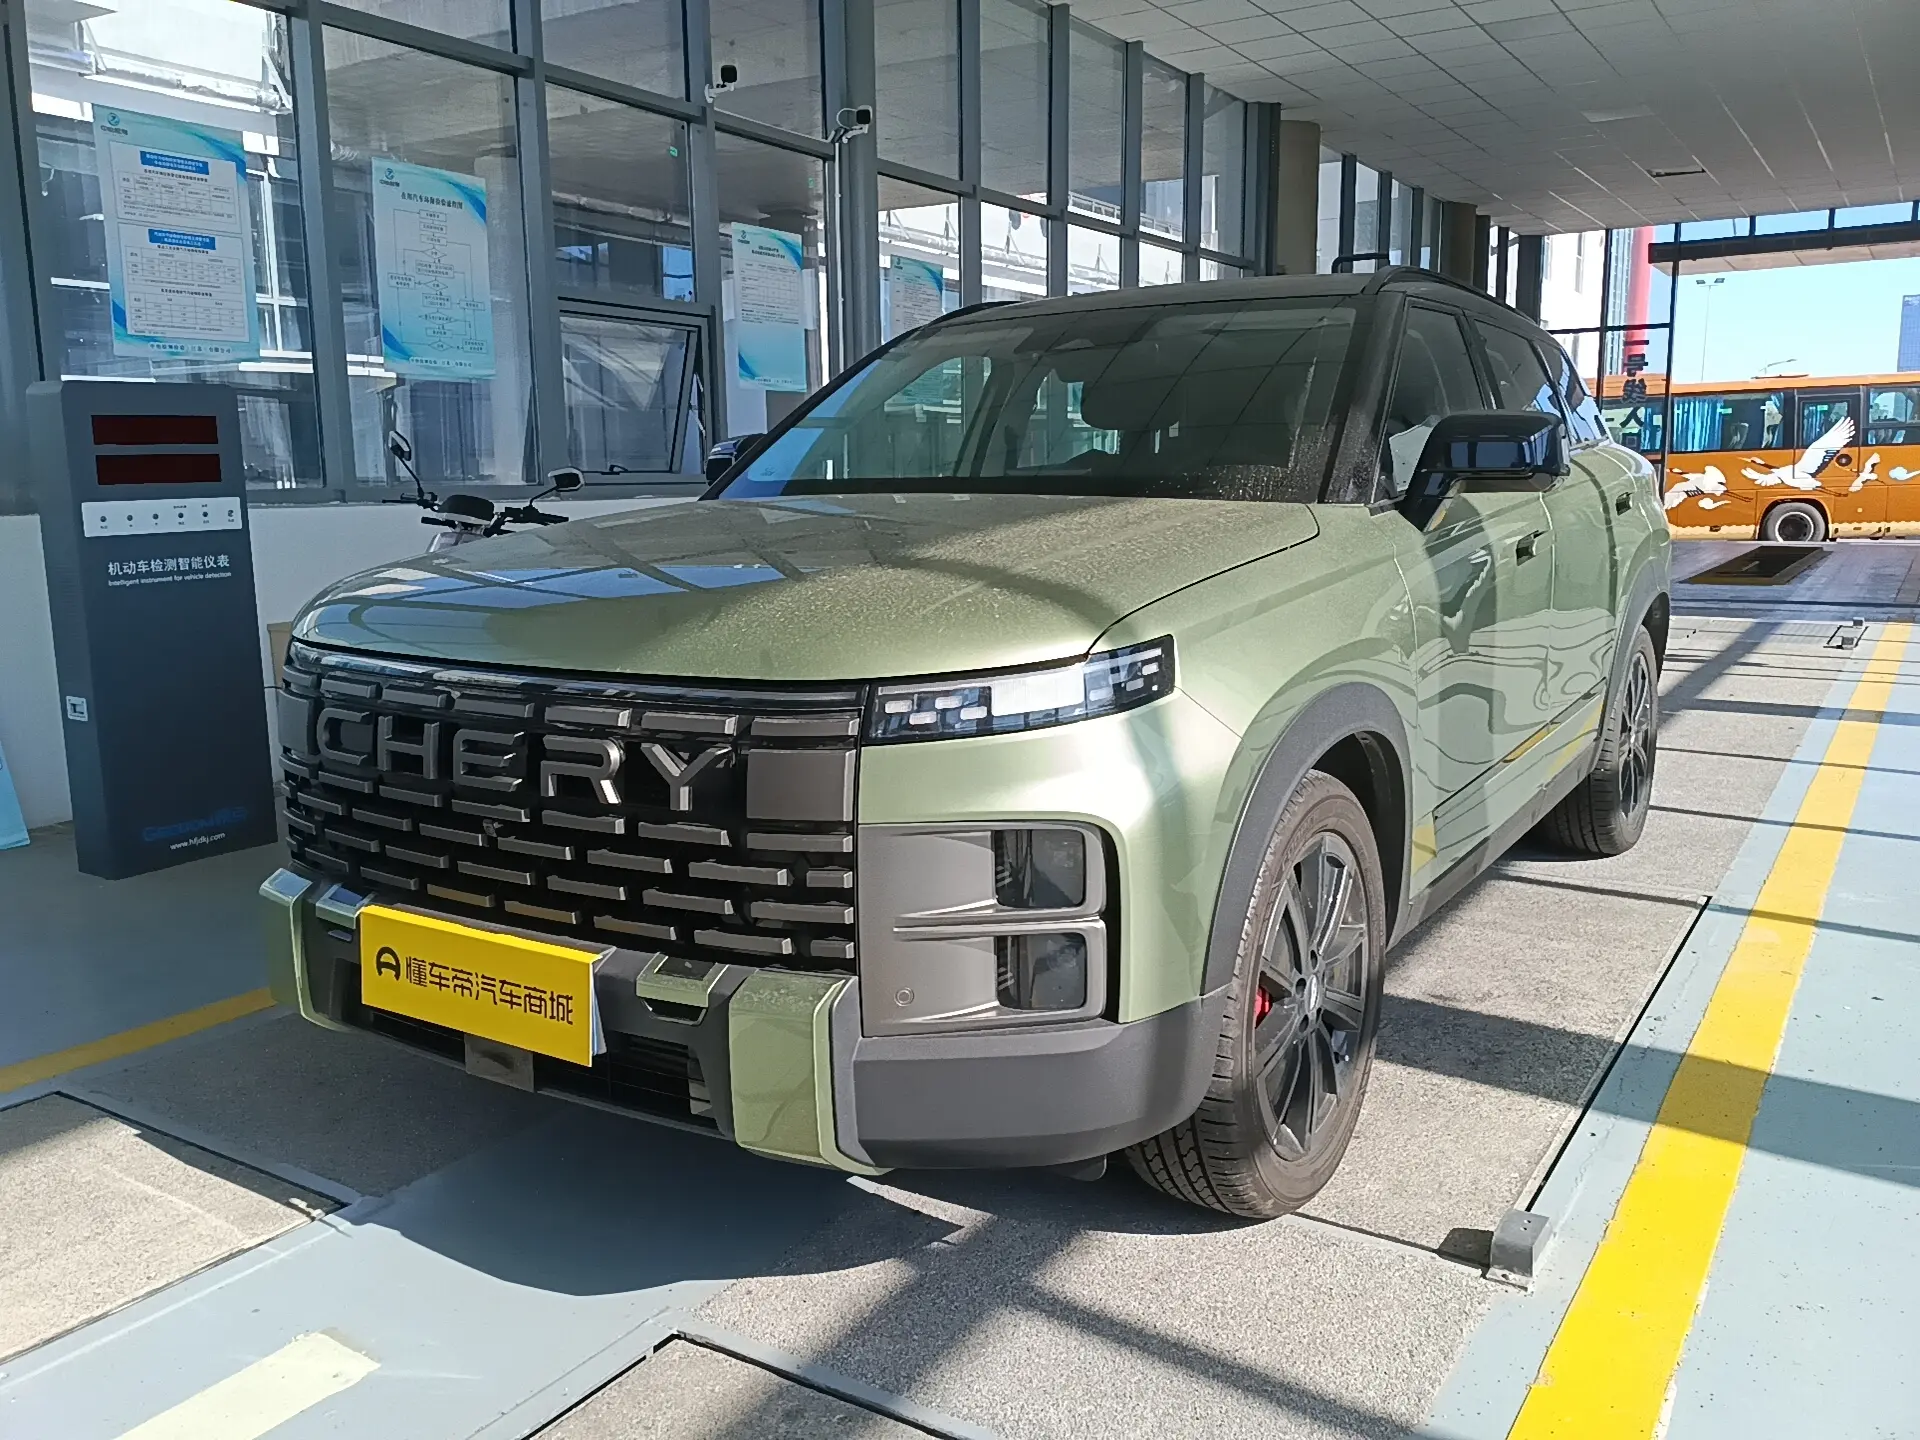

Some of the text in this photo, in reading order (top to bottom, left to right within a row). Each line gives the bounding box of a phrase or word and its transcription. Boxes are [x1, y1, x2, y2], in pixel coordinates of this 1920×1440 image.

[108, 554, 230, 575] 机动车检测智能仪表
[108, 578, 139, 587] Intelligent
[141, 576, 173, 584] instrument
[184, 573, 204, 581] vehicle
[205, 571, 231, 579] detection
[316, 704, 733, 811] CHERY
[405, 955, 574, 1025] 懂车帝汽车商城
